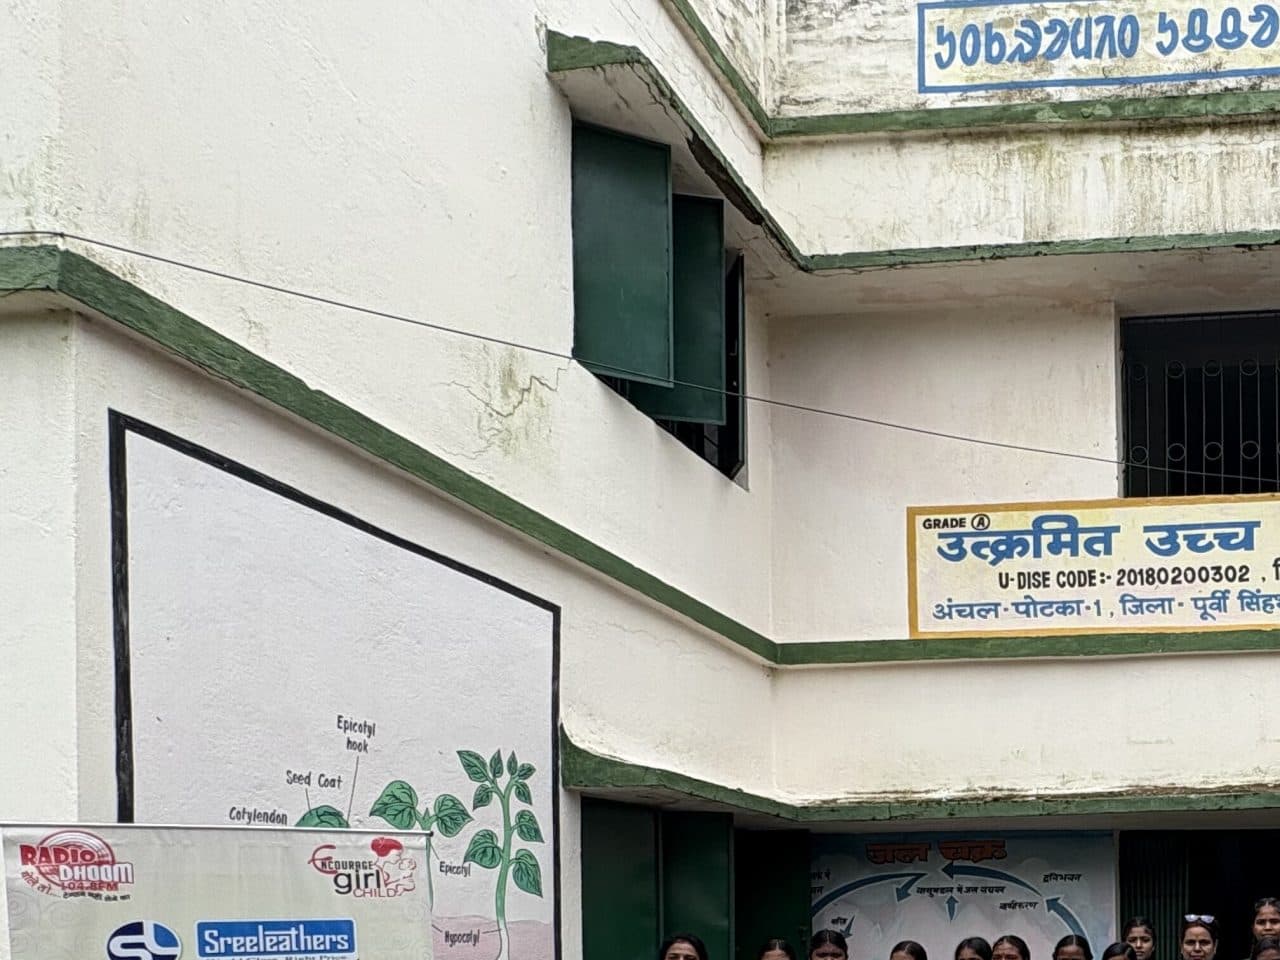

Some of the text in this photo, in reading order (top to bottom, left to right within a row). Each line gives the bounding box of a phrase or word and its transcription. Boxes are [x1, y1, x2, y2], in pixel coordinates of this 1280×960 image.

[922, 517, 966, 530] GRADE
[1143, 520, 1261, 557] उच्च
[1116, 564, 1250, 587] 20180200302
[1191, 588, 1231, 622] पूर्वी
[336, 714, 377, 738] Epicotyl
[346, 737, 369, 754] hook
[285, 769, 343, 791] Seed Coat
[18, 843, 97, 866] RADIO
[59, 862, 134, 884] DHOOM
[333, 867, 382, 895] girl
[353, 886, 399, 898] CHILD
[203, 924, 349, 954] Sreeleathers
